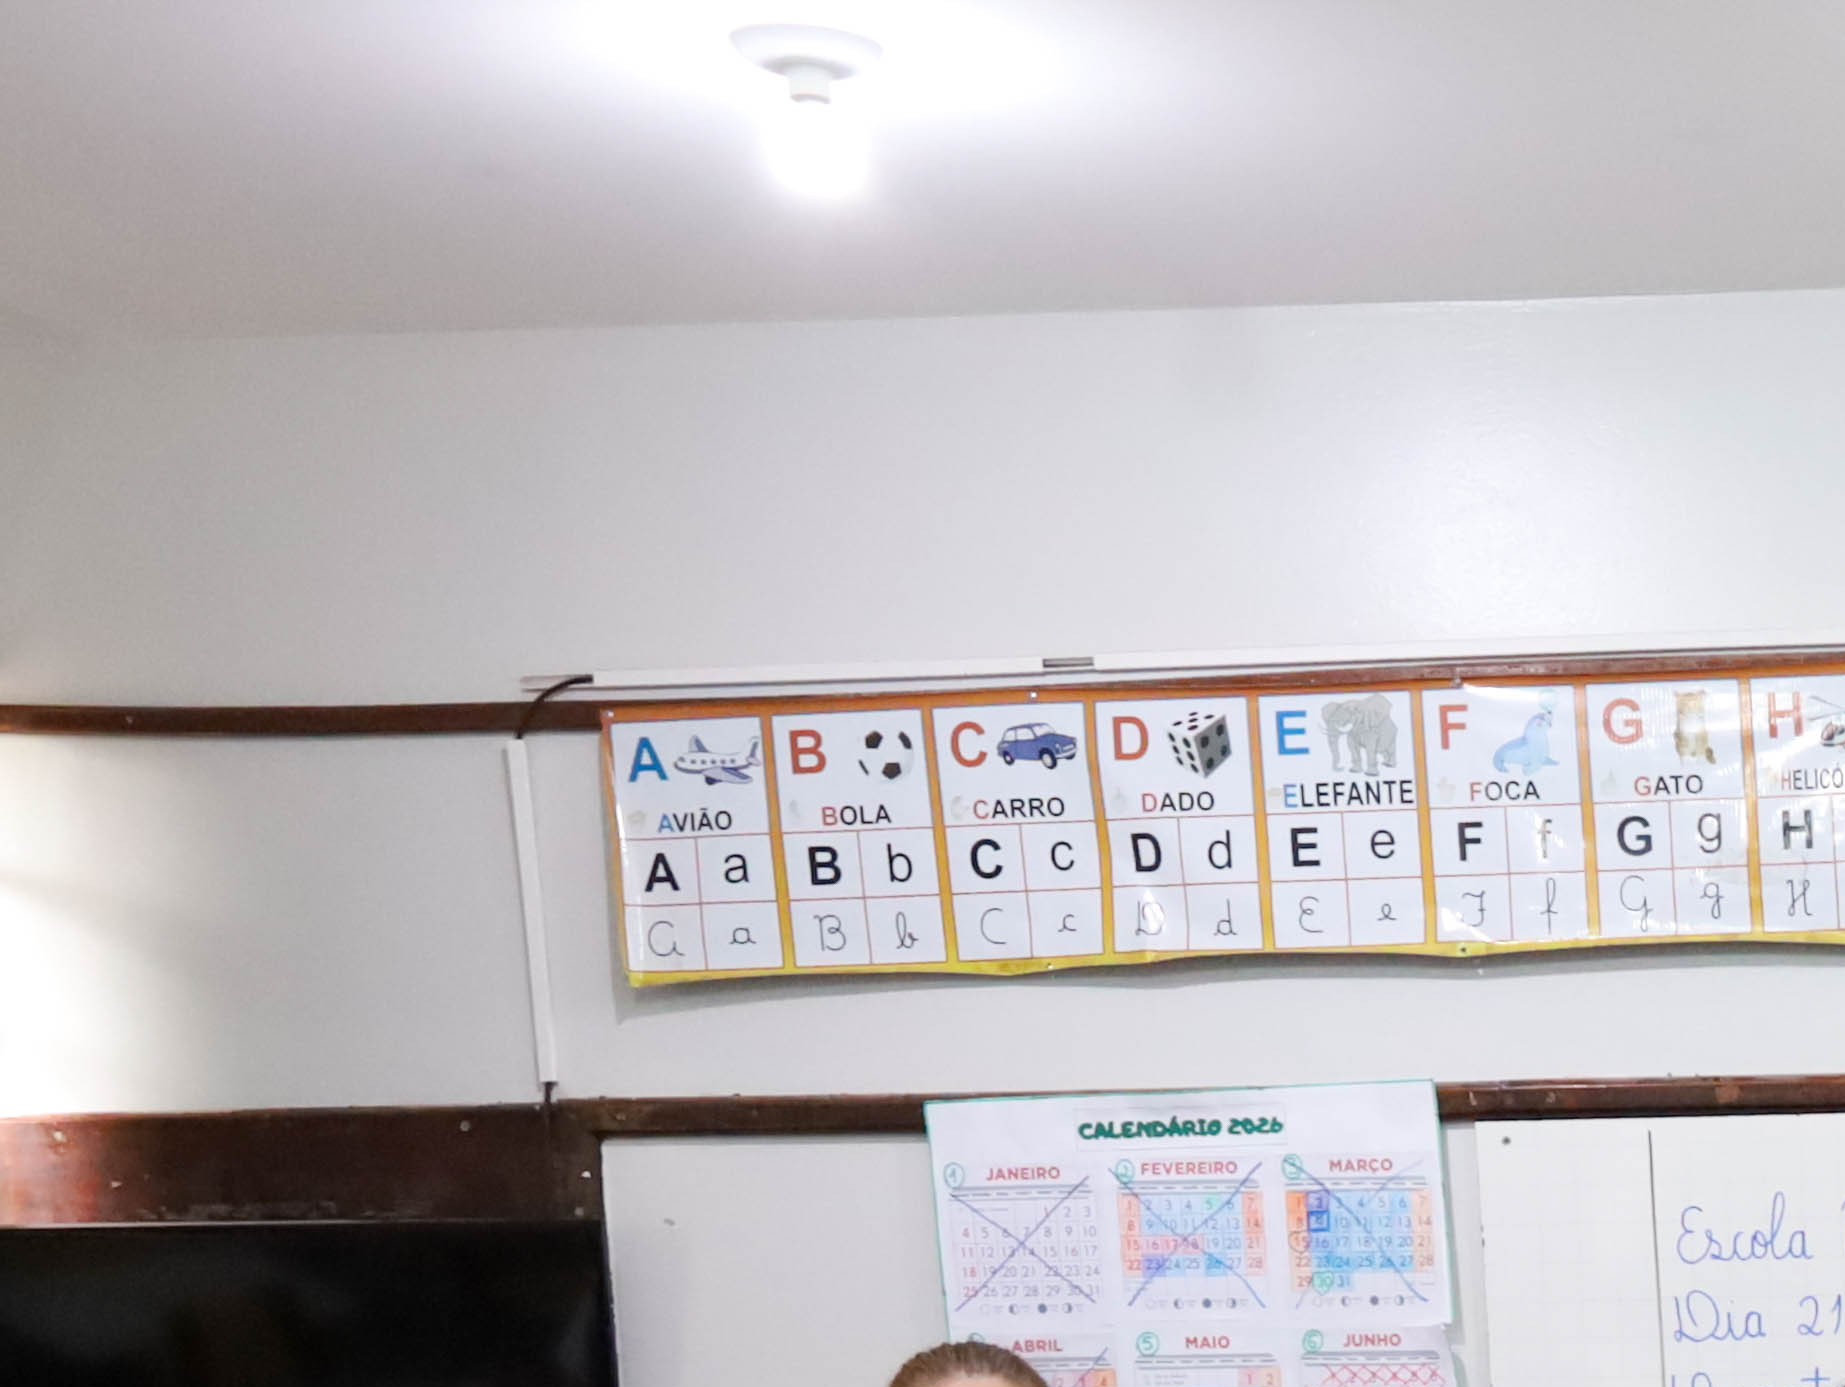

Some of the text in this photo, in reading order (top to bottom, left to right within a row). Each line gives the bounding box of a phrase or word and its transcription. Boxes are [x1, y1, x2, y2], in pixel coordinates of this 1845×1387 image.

[1439, 705, 1469, 749] F
[1602, 699, 1641, 744] G
[1767, 693, 1802, 738] H
[949, 722, 986, 767] C
[1113, 716, 1149, 760] D
[1276, 710, 1310, 755] E
[629, 735, 668, 782] A
[789, 730, 827, 774] B
[1283, 779, 1414, 808] ELEFANTE
[1470, 778, 1541, 803] FOCA
[1634, 771, 1704, 799] GATO
[972, 796, 1065, 820] CARRO
[1141, 788, 1215, 813] DADO
[657, 806, 732, 834] AVIÃO
[822, 802, 892, 828] BOLA
[1078, 1115, 1283, 1141] CALENDÁRIO 2026
[985, 1166, 1060, 1181] JANEIRO
[1140, 1160, 1238, 1175] FEVEREIRO
[1329, 1158, 1393, 1174] MARÇO
[1677, 1191, 1812, 1265] Escola
[1674, 1290, 1767, 1342] Dia
[1798, 1294, 1843, 1335] 21
[1013, 1339, 1062, 1354] ABRIL
[1185, 1335, 1230, 1350] MAIO
[1343, 1333, 1401, 1347] JUNHO
